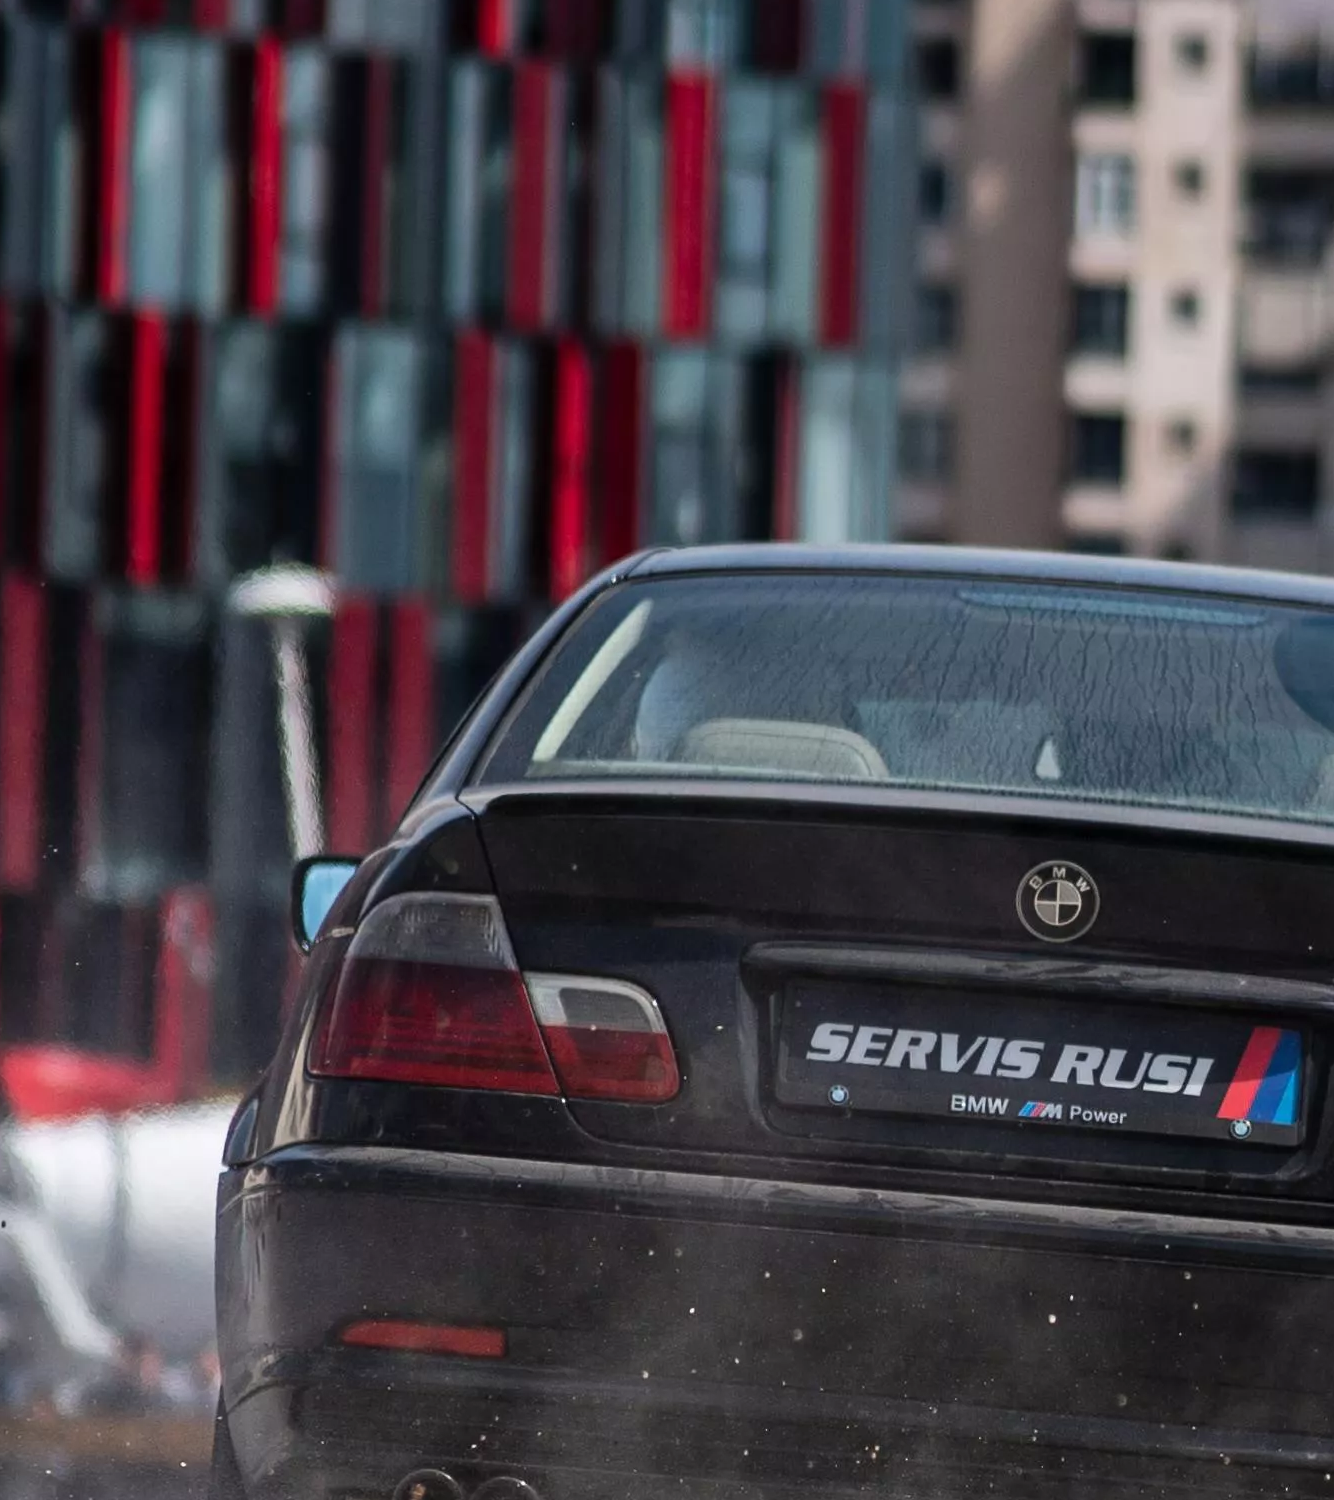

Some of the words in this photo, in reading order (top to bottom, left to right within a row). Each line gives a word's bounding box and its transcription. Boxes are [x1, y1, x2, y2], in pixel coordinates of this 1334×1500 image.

[1029, 866, 1091, 893] BMW
[805, 1022, 1045, 1079] SERVIS
[1050, 1043, 1215, 1097] RUSI
[950, 1094, 1009, 1115] BMW
[1070, 1105, 1128, 1125] Power
